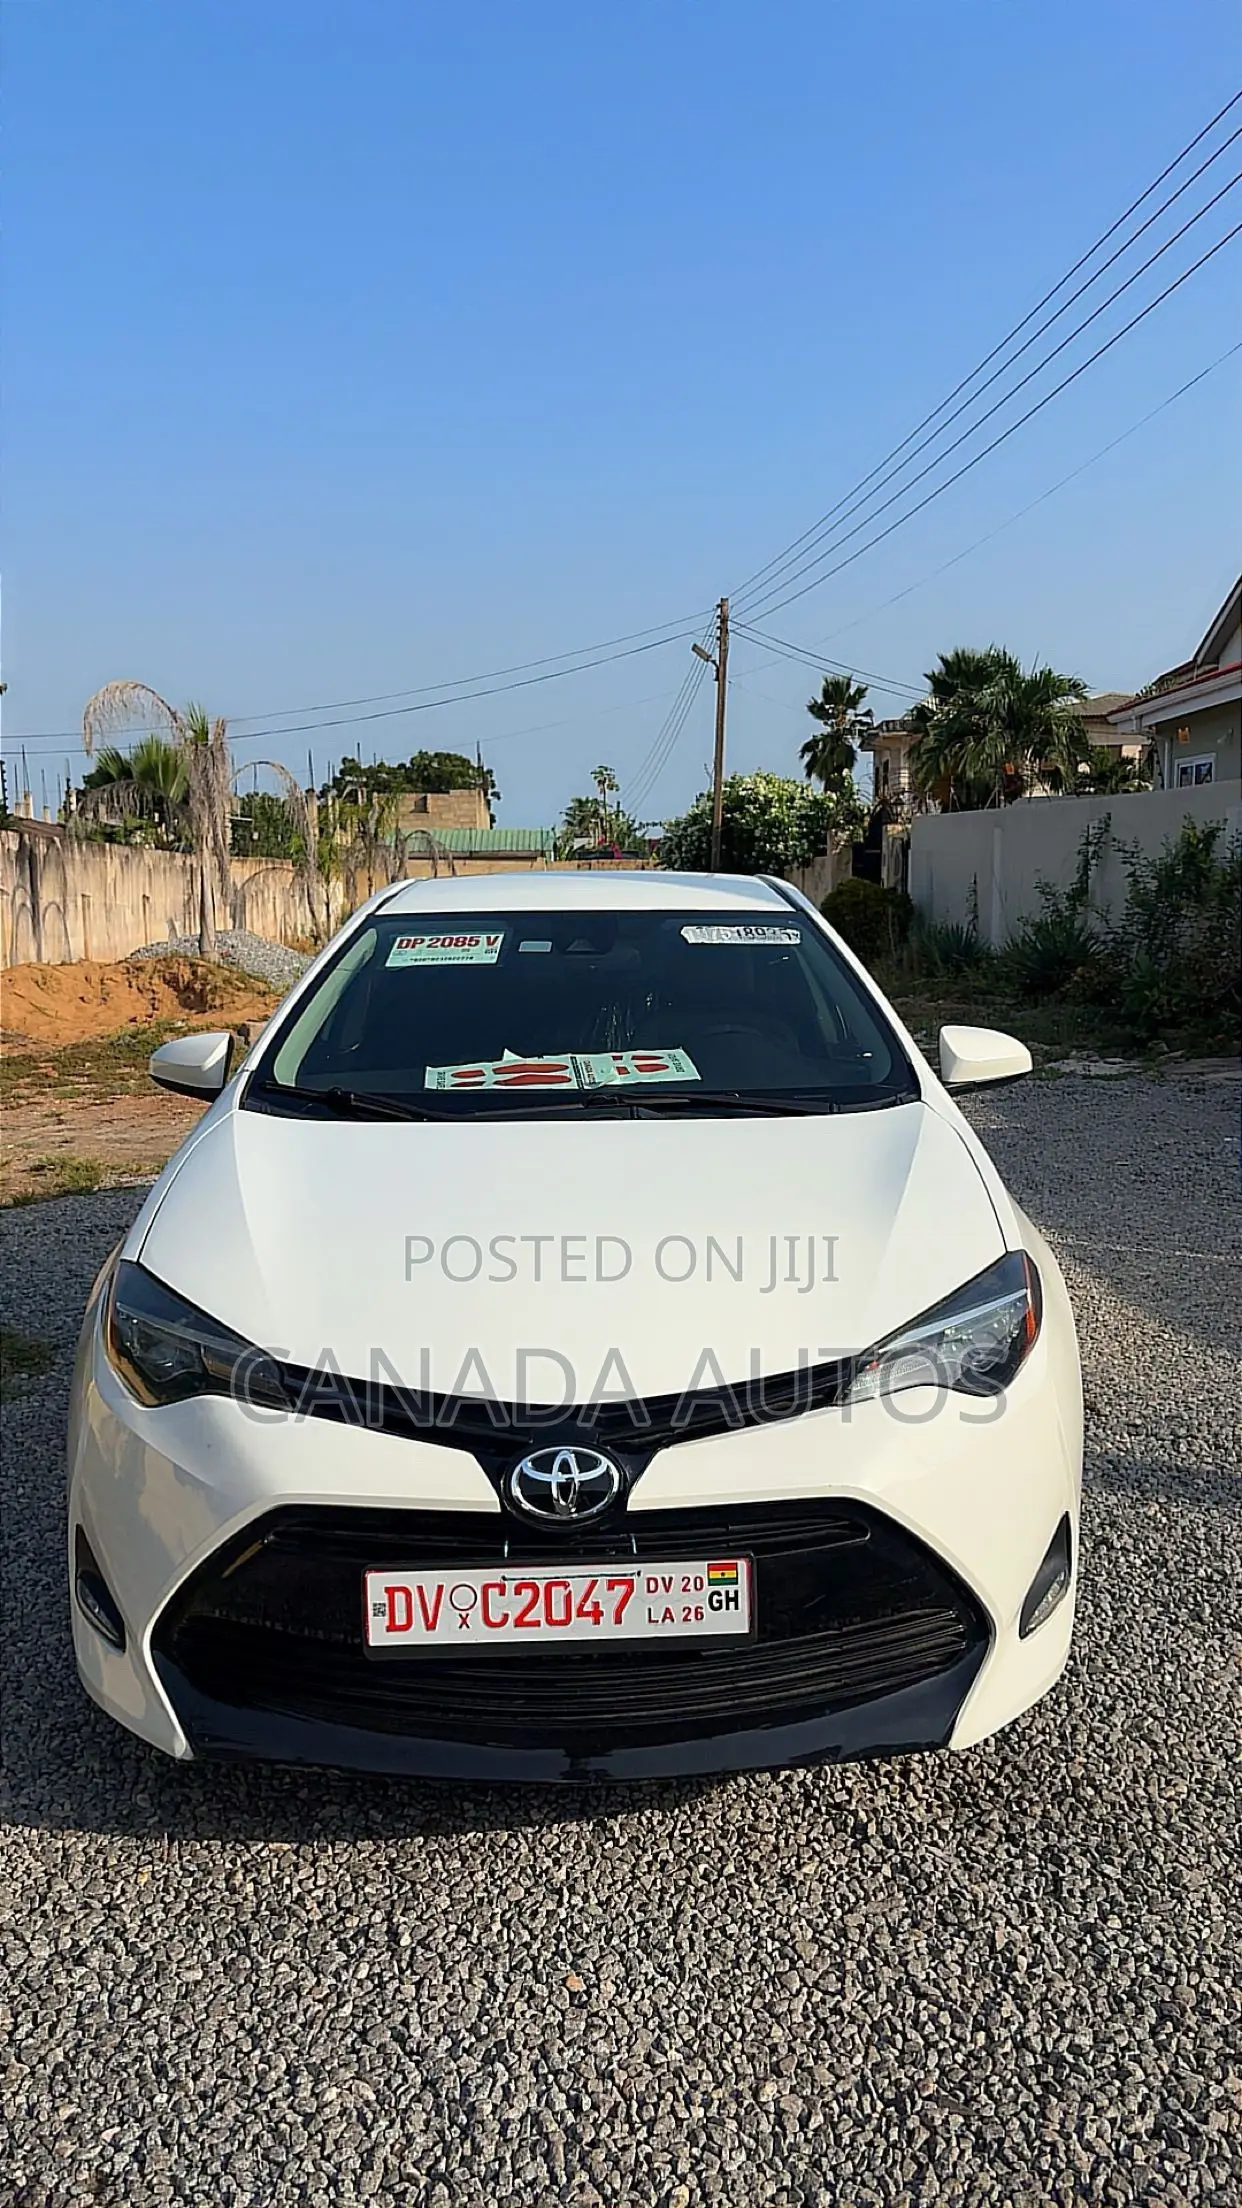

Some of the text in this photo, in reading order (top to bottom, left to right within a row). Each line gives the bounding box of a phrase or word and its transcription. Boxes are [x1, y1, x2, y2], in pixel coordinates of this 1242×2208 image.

[397, 936, 500, 950] DP 2085 V
[646, 1576, 704, 1594] DV 20
[384, 1579, 634, 1633] DV C2047
[708, 1590, 739, 1612] GH
[647, 1606, 704, 1624] LA 26
